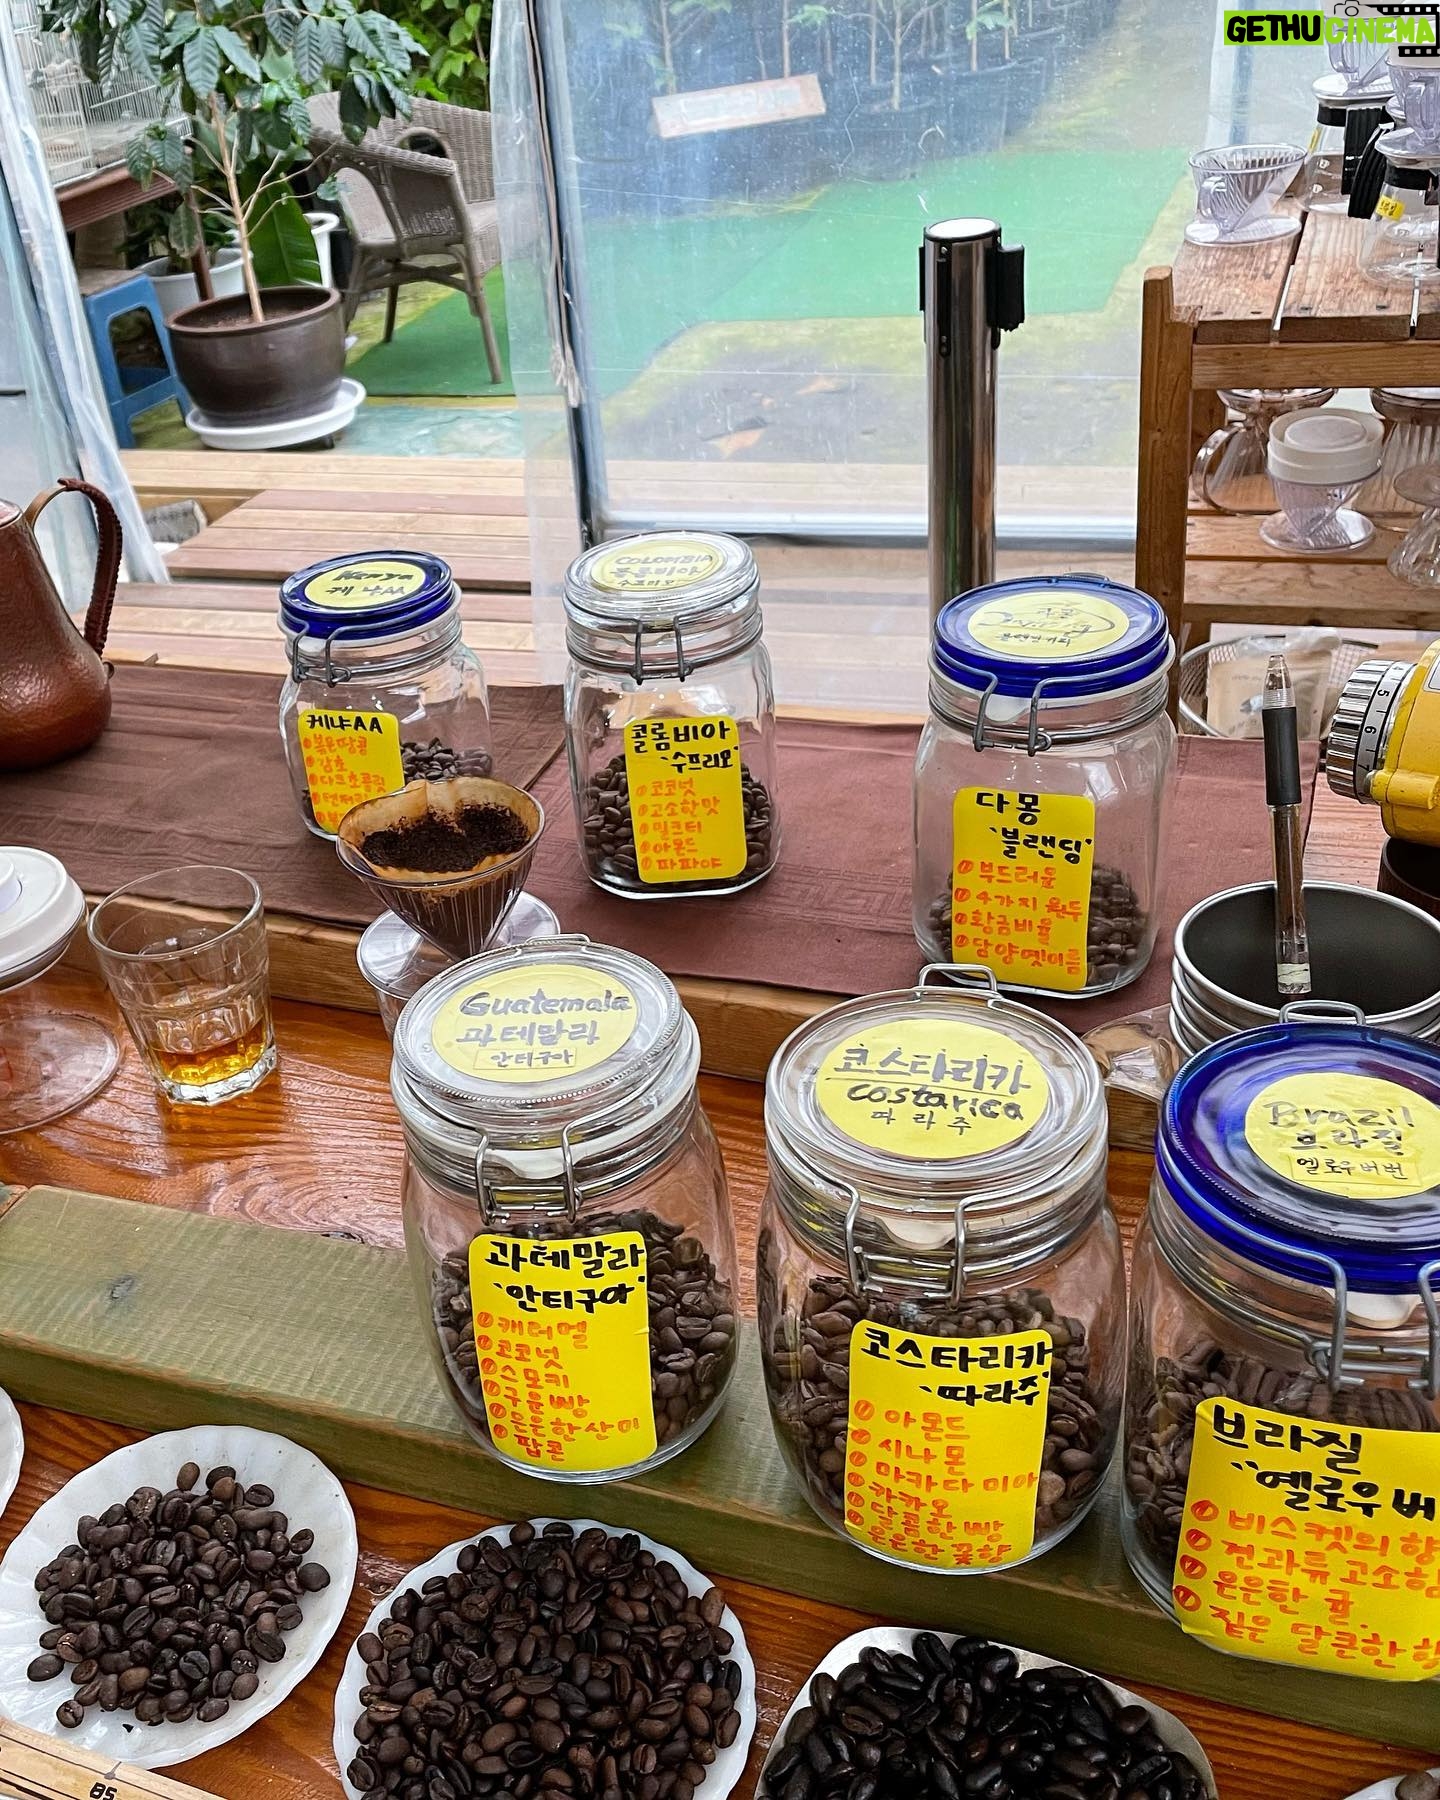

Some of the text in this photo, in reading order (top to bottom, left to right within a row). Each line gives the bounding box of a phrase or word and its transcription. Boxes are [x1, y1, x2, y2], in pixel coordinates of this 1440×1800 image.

[1376, 688, 1391, 698] 5
[306, 714, 383, 734] 케냐AA
[631, 720, 731, 753] 콜롬비아
[1363, 725, 1377, 735] 6
[650, 777, 696, 797] 코코넛
[975, 792, 1041, 826] 다몽
[652, 821, 703, 841] 밀크티
[652, 838, 698, 857] 아몬드
[656, 857, 723, 871] 파파야
[459, 988, 632, 1017] Guatemala
[490, 1049, 574, 1068] 안티구아
[834, 1043, 1031, 1095] 코스타리카
[1262, 1101, 1415, 1128] Brazil
[485, 1240, 645, 1279] 과테말라
[495, 1339, 564, 1370] 코코넛
[860, 1327, 1053, 1374] 코스타리카
[500, 1364, 570, 1389] 스모키
[884, 1410, 970, 1442] 아몬드
[1212, 1403, 1363, 1475] 브라질
[513, 1433, 566, 1462] 팝콘
[878, 1438, 966, 1476] 시나몬
[875, 1461, 1039, 1493] 마카다미아
[868, 1481, 953, 1519] 카카오
[1212, 1570, 1309, 1615] 은은한
